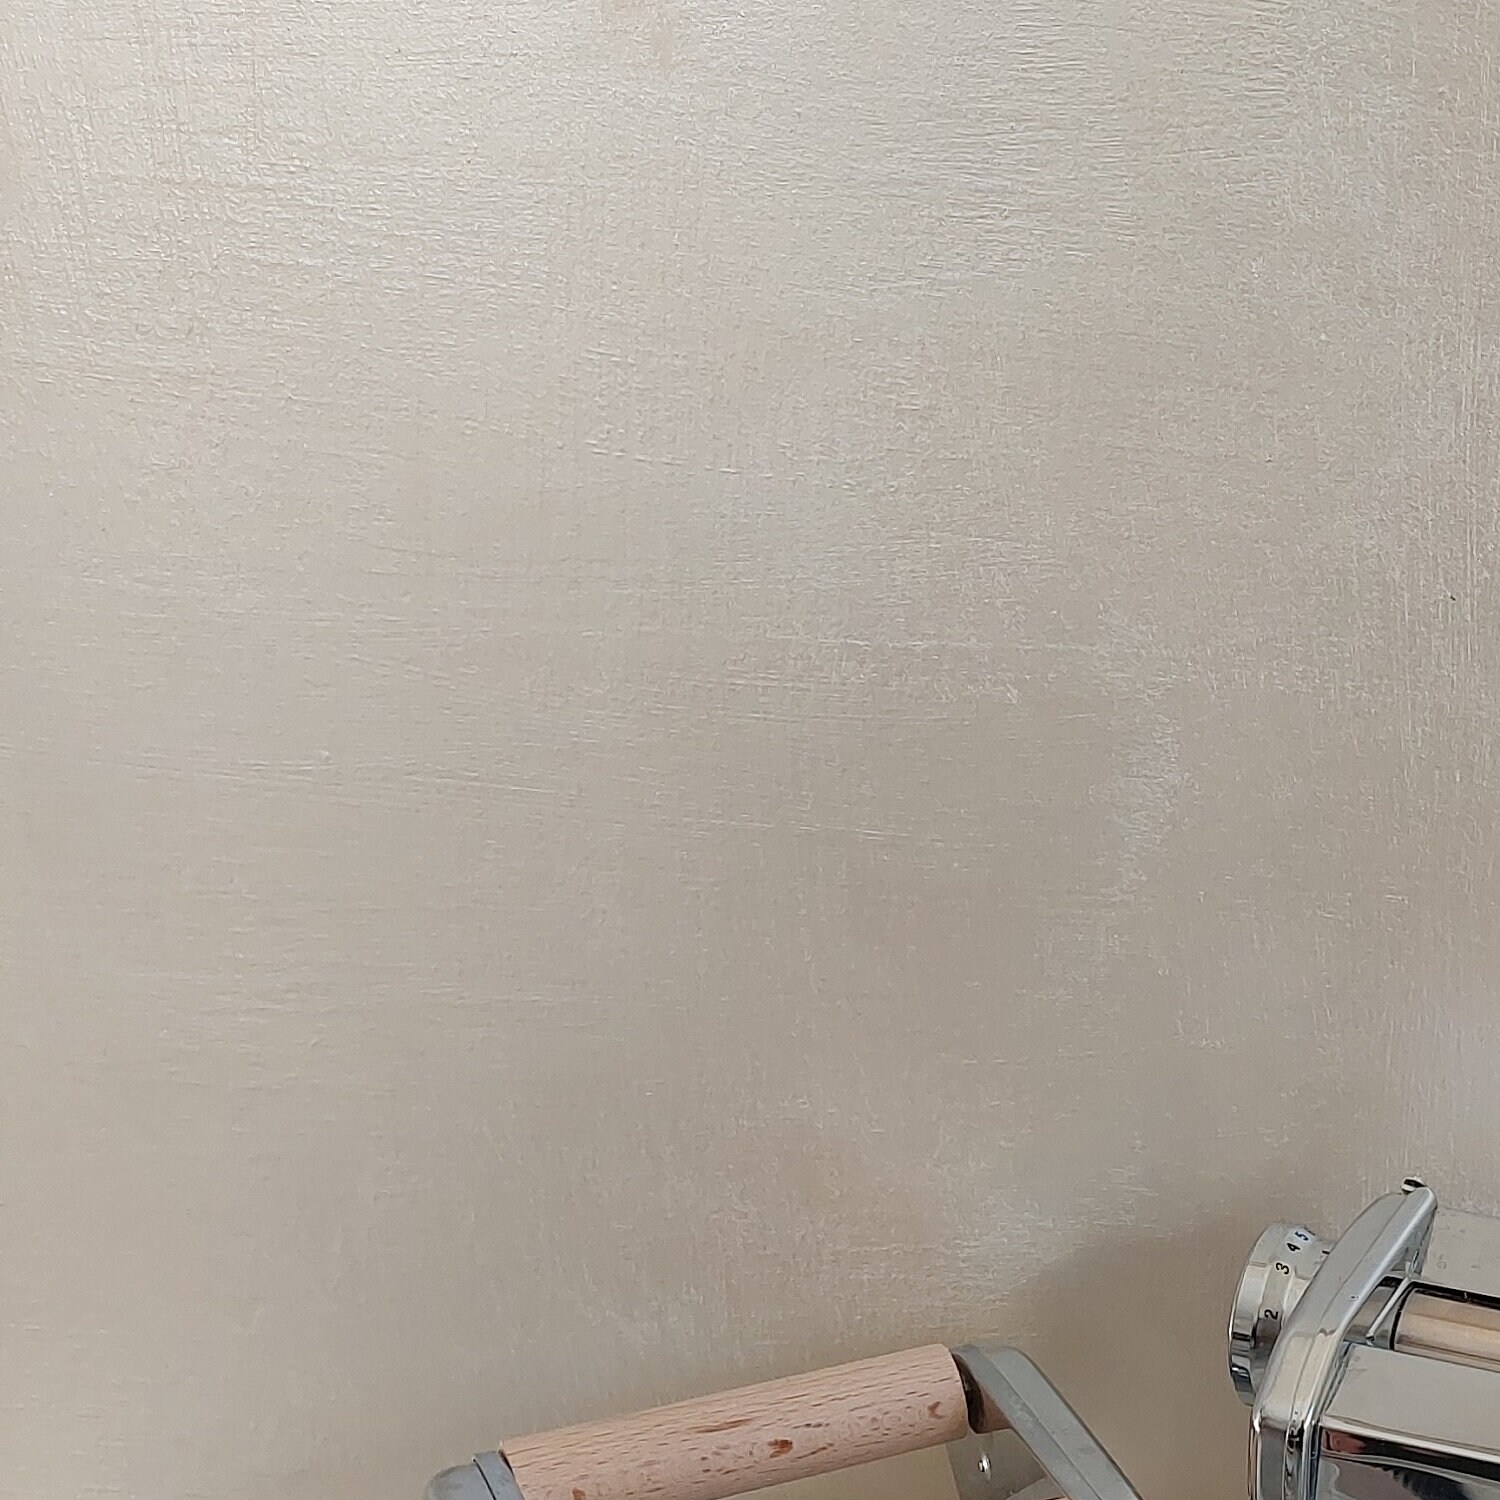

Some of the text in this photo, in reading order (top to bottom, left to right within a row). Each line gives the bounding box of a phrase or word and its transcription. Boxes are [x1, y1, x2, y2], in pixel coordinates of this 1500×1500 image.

[1294, 1230, 1309, 1241] 5
[1286, 1242, 1301, 1252] 4
[1275, 1261, 1290, 1275] 3
[1264, 1308, 1279, 1321] 2
